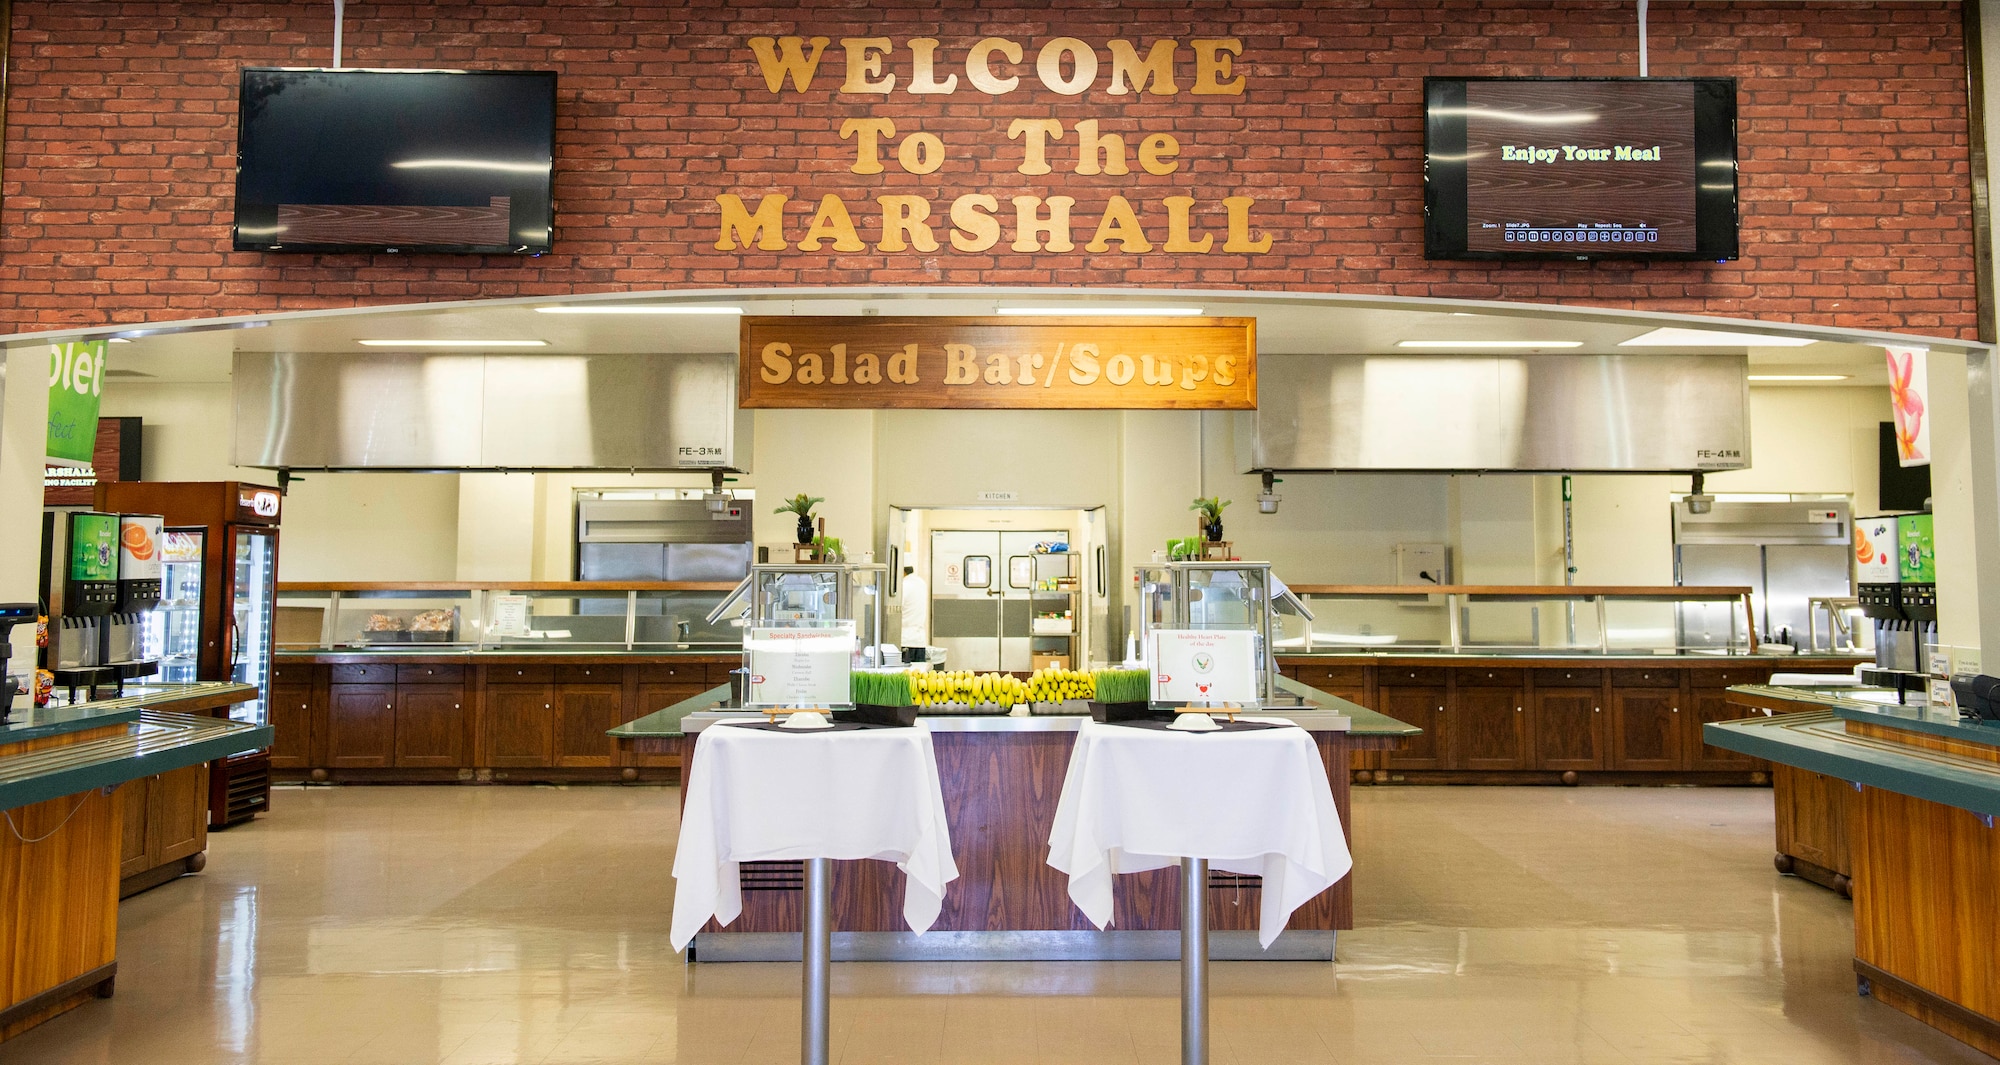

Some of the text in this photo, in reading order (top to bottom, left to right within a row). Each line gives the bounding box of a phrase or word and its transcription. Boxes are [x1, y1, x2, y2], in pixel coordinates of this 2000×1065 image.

[747, 36, 1247, 96] WELCOME
[839, 117, 1181, 176] To The
[1501, 145, 1661, 164] Enjoy Your Meal
[713, 193, 1274, 254] MARSHALL
[760, 341, 1238, 391] Salad Bar/Soups
[769, 632, 795, 640] Specialty
